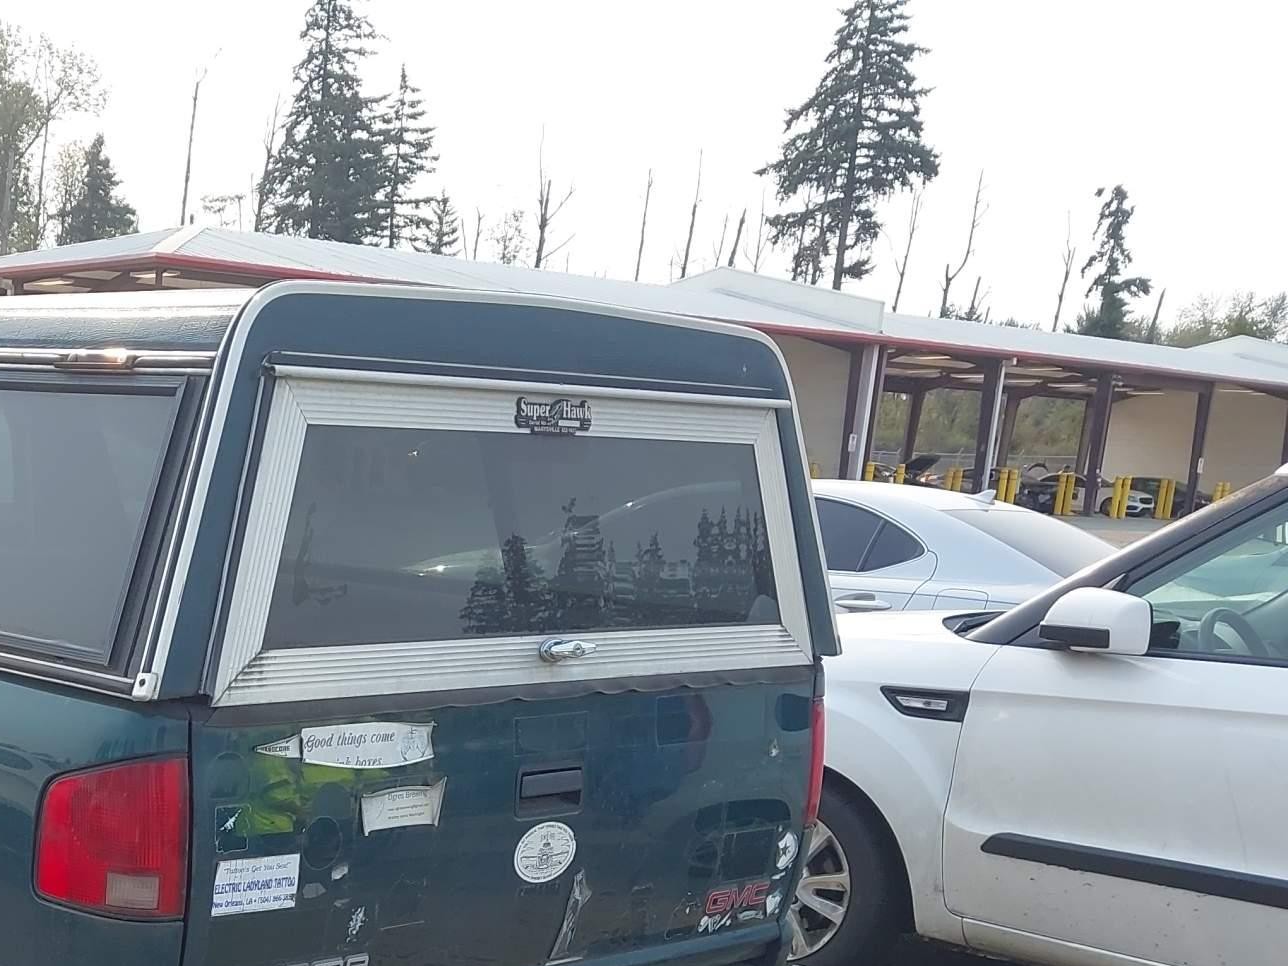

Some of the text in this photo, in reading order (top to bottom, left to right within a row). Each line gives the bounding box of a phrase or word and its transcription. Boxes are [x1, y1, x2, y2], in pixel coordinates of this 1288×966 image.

[520, 398, 592, 420] Super Hawk
[304, 731, 396, 753] Good things come
[215, 882, 242, 895] ELECTRIC
[705, 881, 770, 914] GMC
